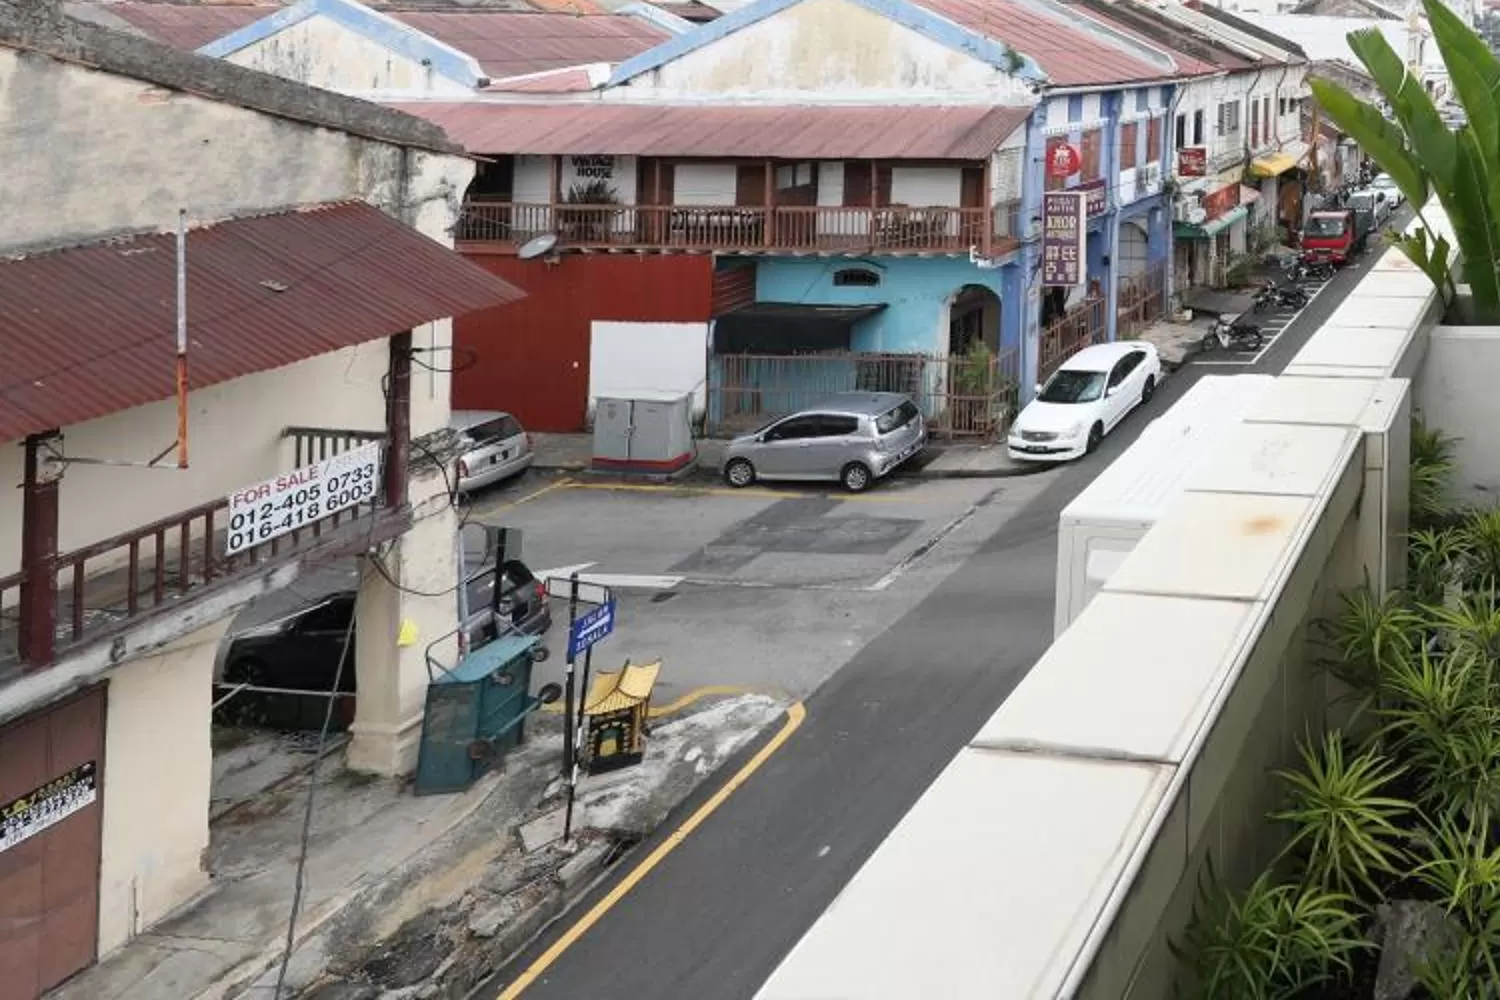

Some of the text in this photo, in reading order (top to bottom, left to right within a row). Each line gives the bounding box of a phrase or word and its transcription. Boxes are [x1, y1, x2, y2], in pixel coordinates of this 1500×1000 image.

[230, 480, 373, 550] 016-418 6003
[231, 464, 374, 530] 012-405 0733
[233, 484, 271, 508] FOR
[276, 465, 319, 493] SALE
